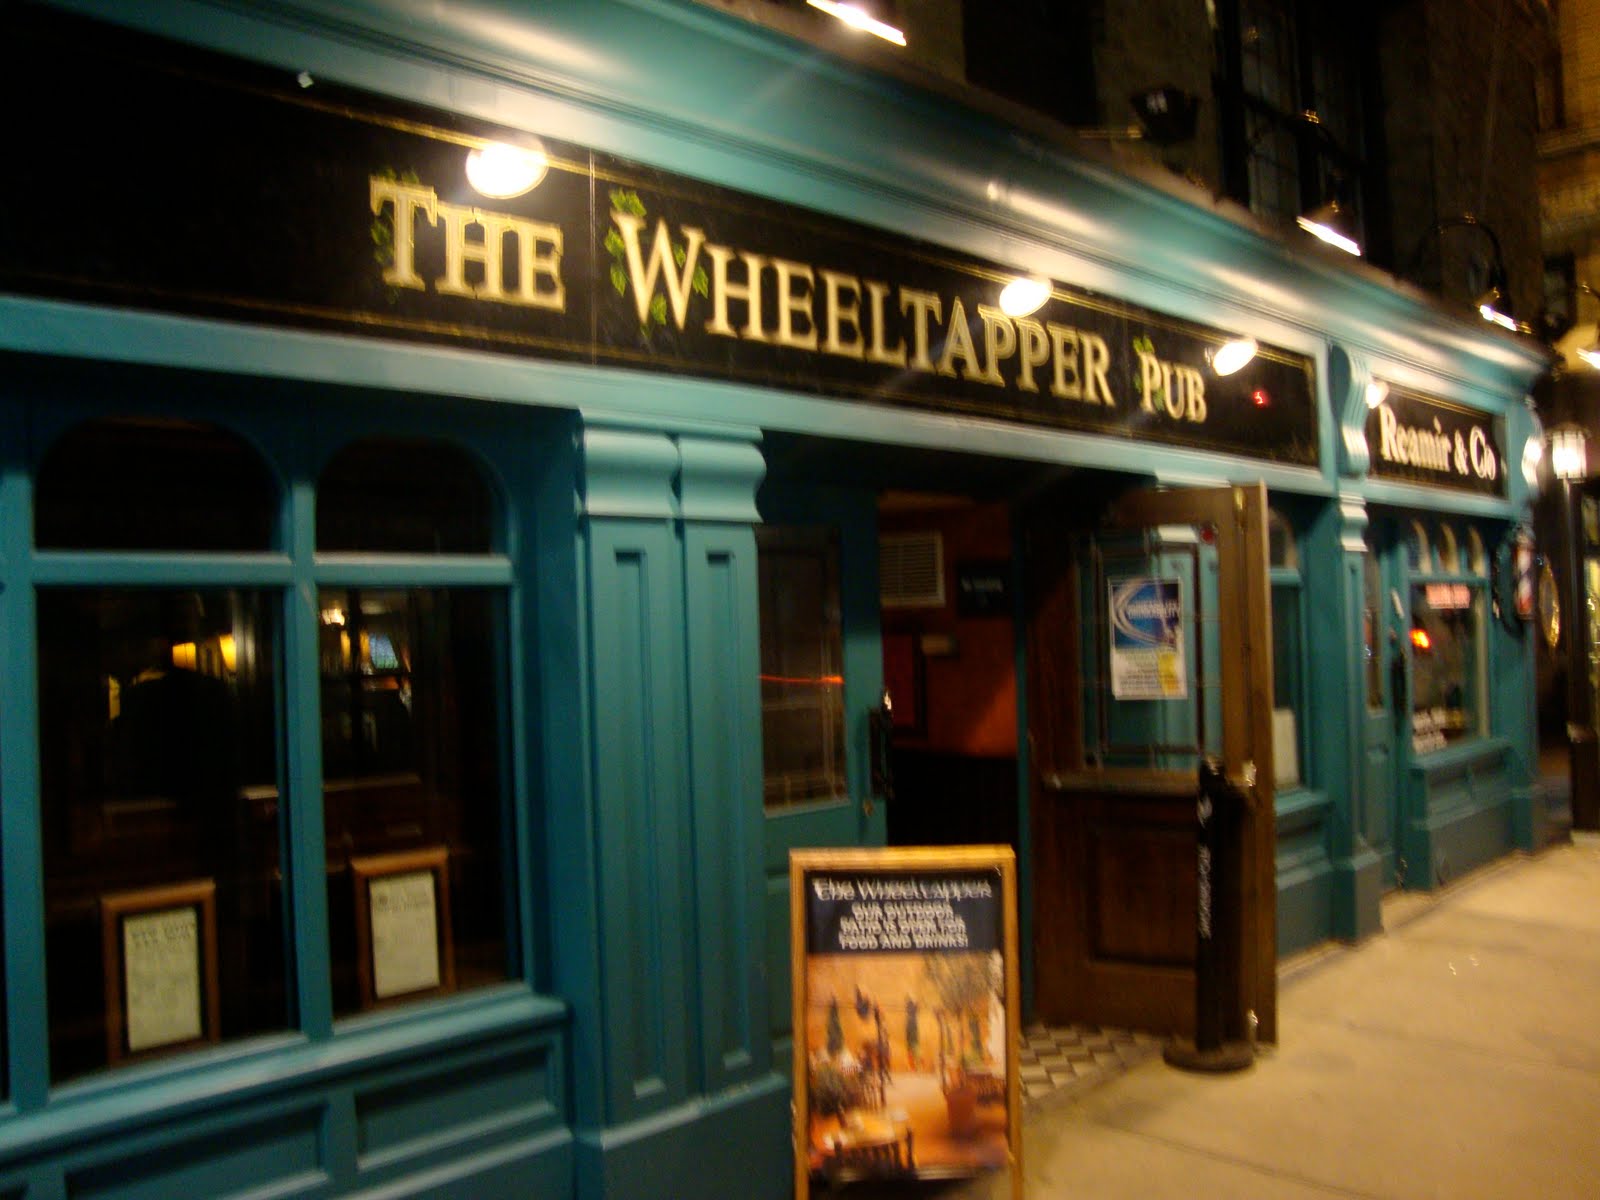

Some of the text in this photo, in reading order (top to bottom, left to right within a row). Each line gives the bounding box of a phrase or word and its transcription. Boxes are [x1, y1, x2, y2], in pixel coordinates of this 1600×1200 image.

[370, 176, 1207, 424] THE WHEELTAPPER PUB
[1378, 402, 1451, 473] Reamir
[1454, 430, 1469, 475] &
[852, 901, 954, 921] OUR OUTDOOR
[840, 914, 967, 935] PATIO IS OPEN FOR
[839, 931, 879, 950] FOOD
[879, 931, 912, 950] AND
